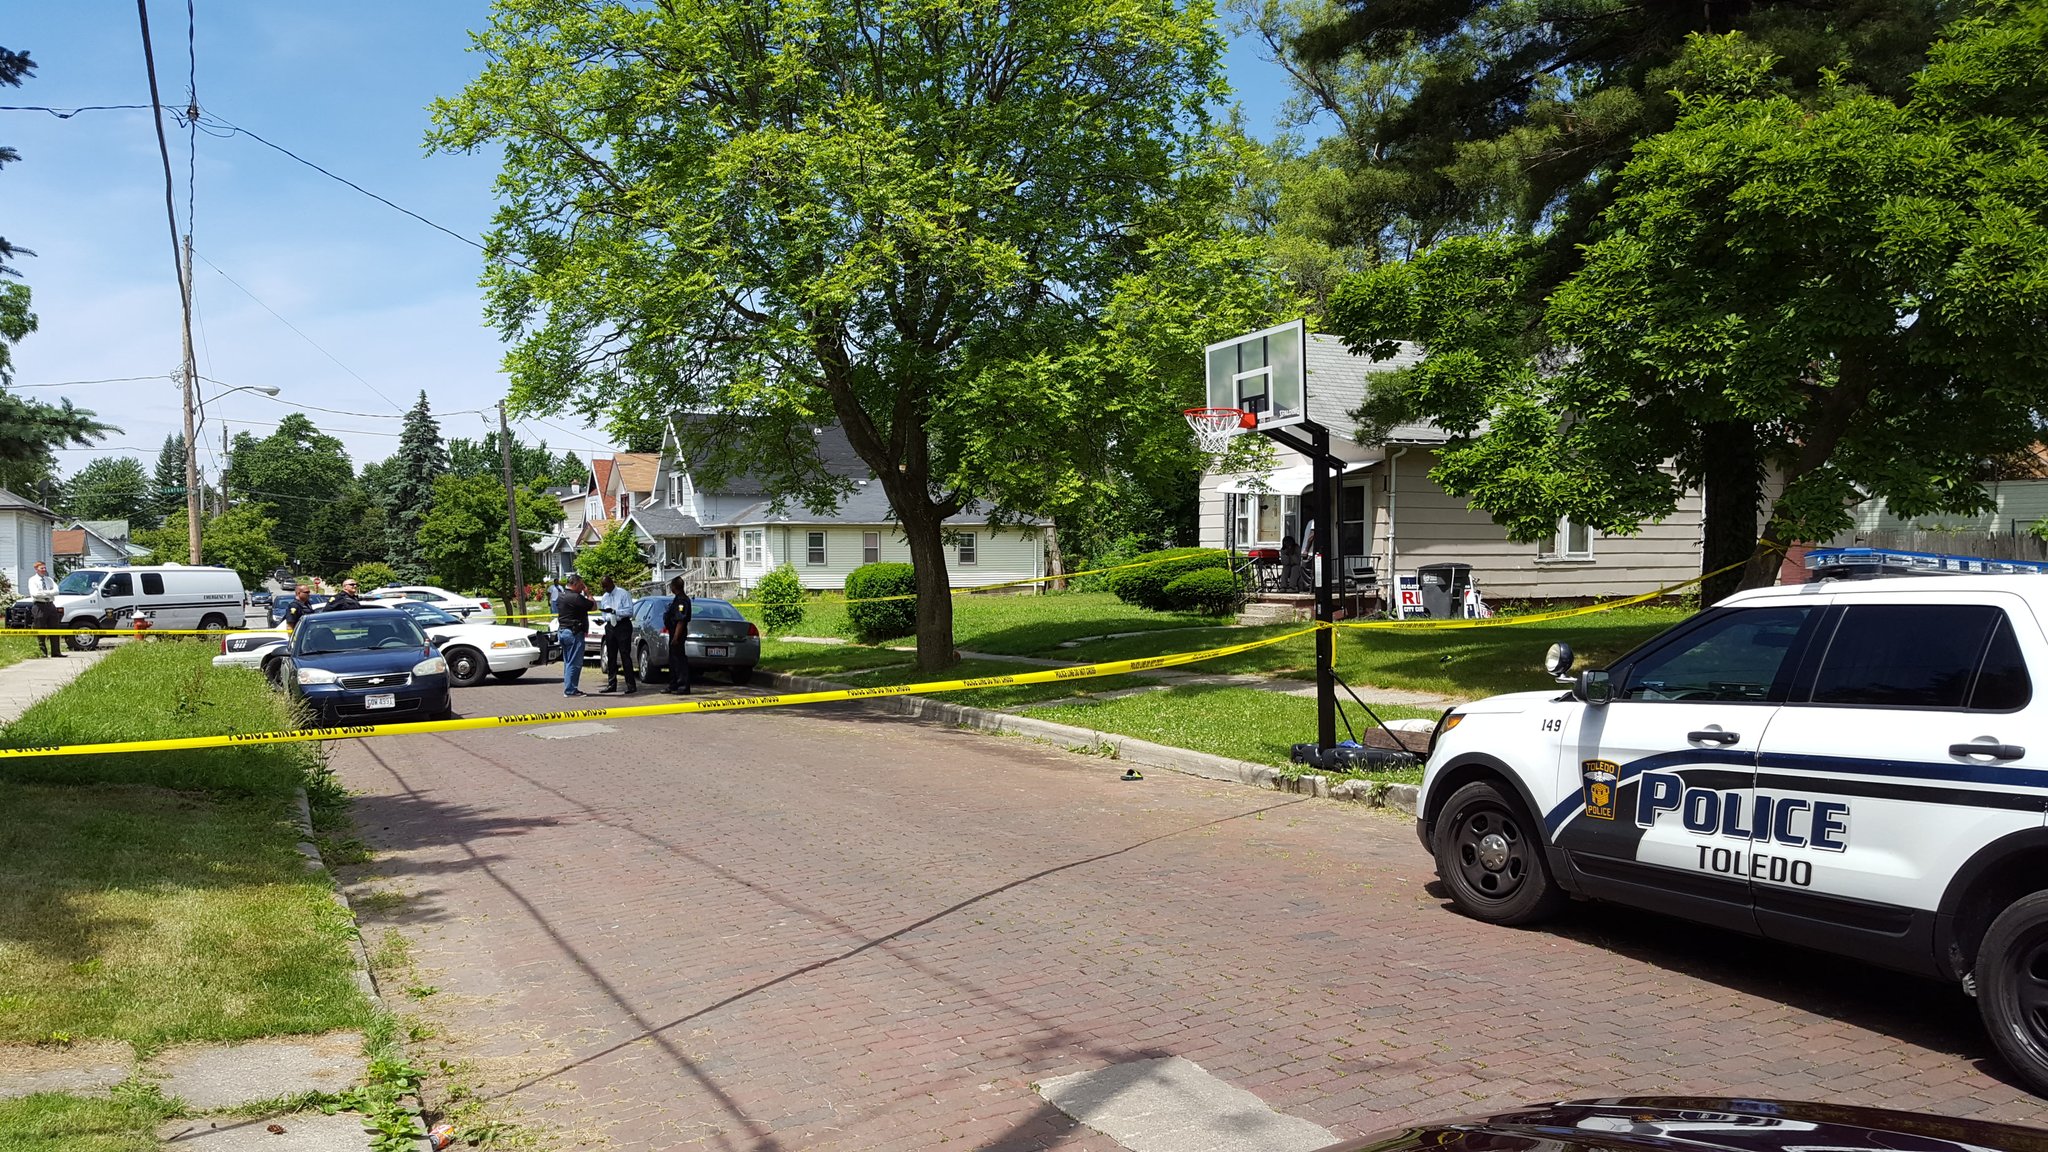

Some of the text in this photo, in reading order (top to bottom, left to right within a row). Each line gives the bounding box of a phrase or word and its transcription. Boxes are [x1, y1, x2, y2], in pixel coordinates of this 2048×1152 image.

[116, 610, 157, 620] POCE
[1541, 719, 1562, 732] 149
[1586, 761, 1615, 774] TOLEDO
[1588, 805, 1612, 817] POLICE
[1635, 769, 1850, 853] POLICE
[1696, 844, 1812, 887] TOLEDO
